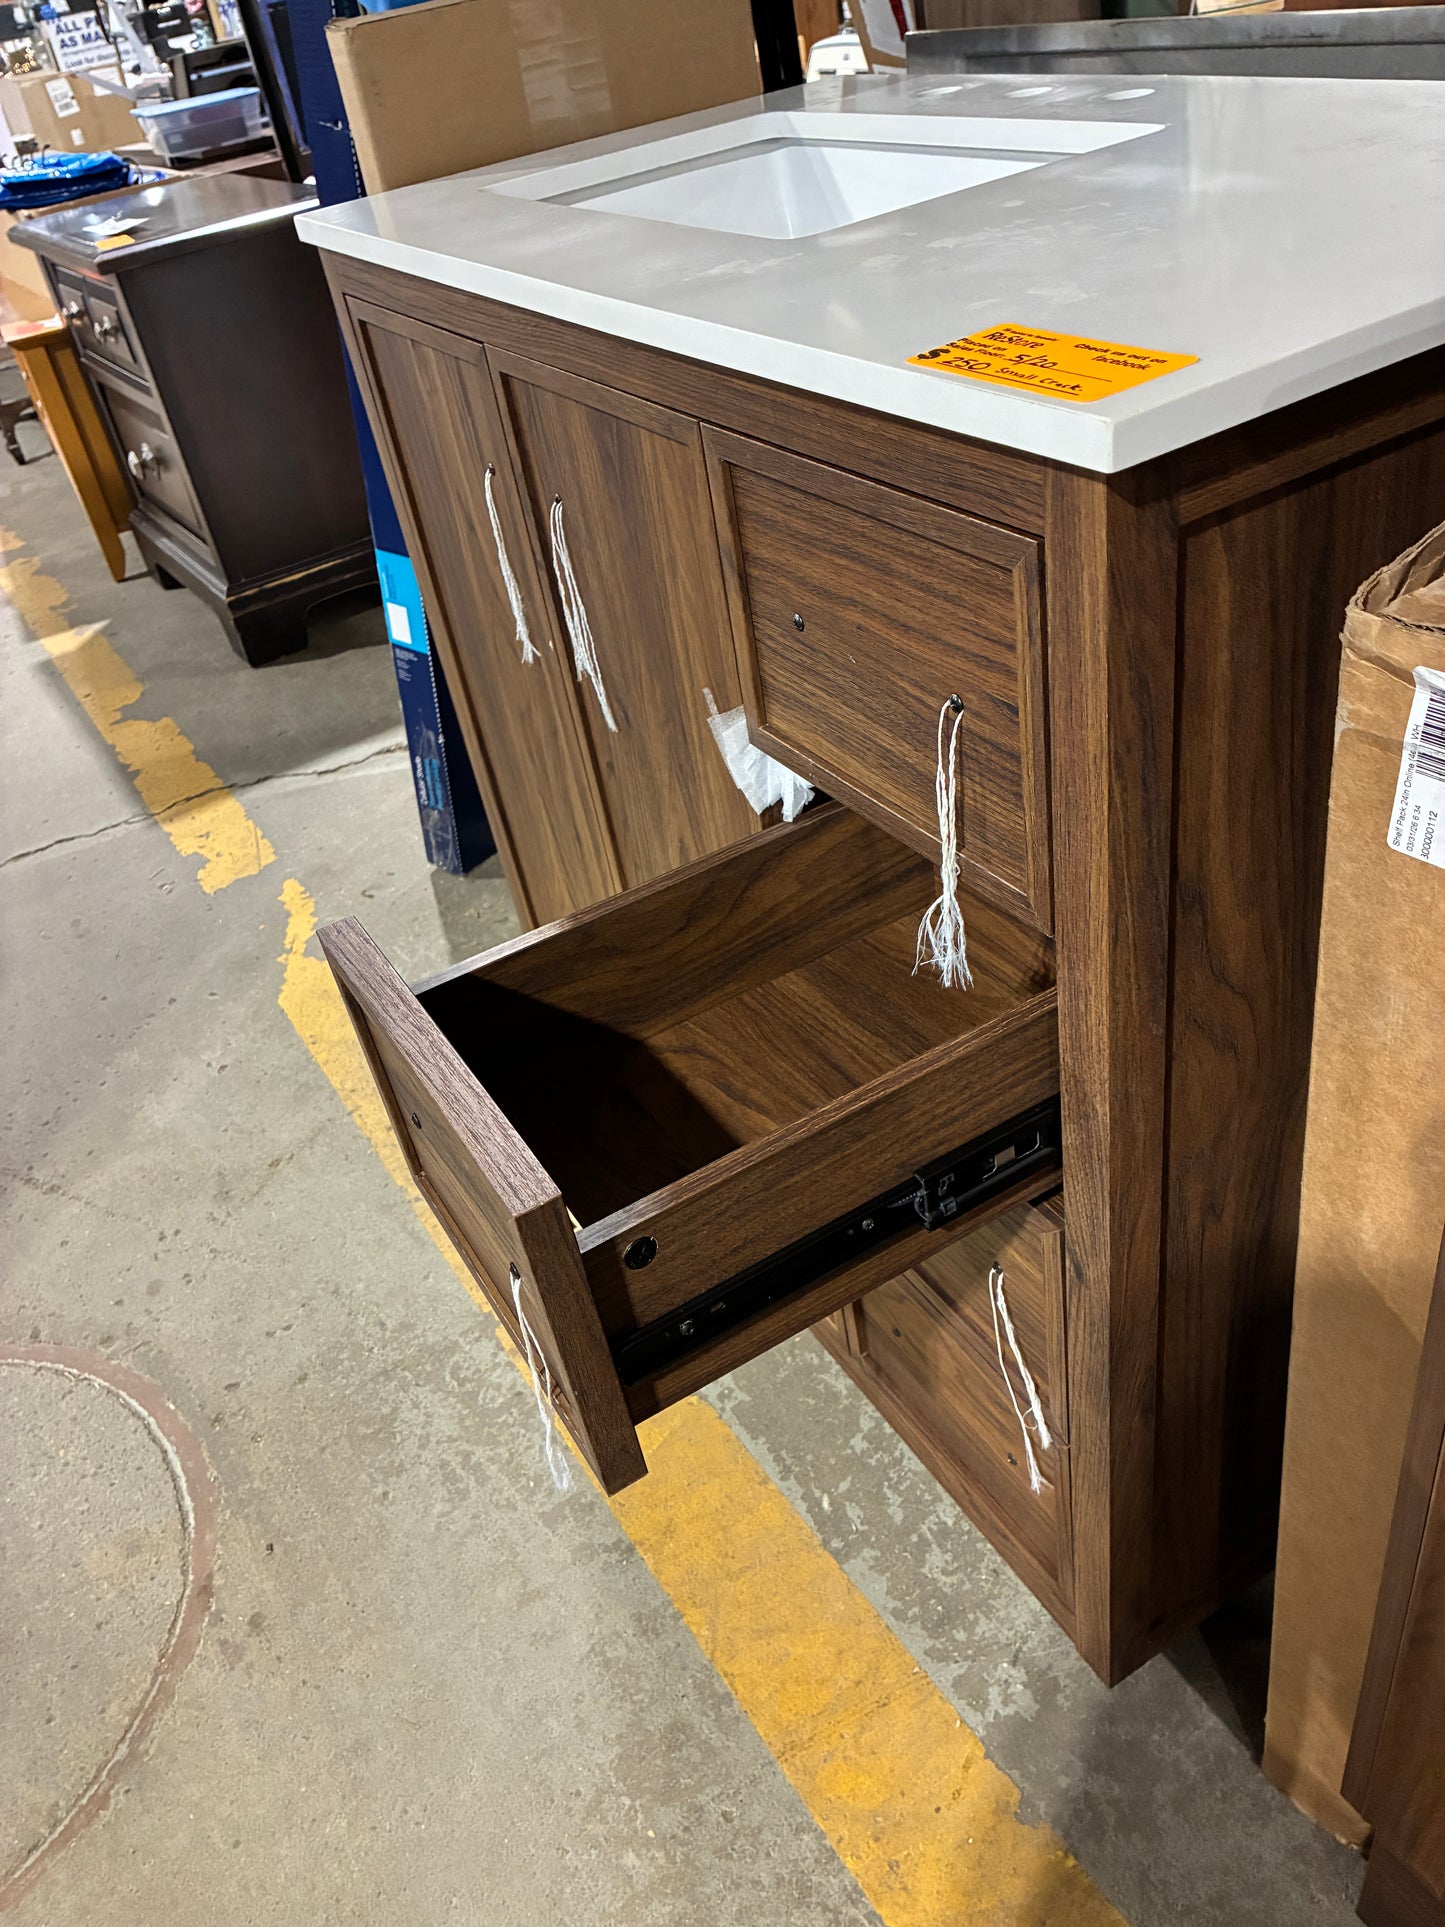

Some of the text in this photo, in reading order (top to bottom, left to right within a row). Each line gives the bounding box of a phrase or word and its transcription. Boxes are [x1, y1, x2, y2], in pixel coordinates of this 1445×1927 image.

[55, 20, 81, 35] ALL
[60, 35, 78, 49] AS
[982, 332, 1044, 348] ReStore
[1074, 343, 1111, 353] Check
[941, 356, 992, 370] 250
[995, 367, 1038, 380] Small
[1010, 354, 1059, 368] 5/20
[1091, 355, 1152, 370] facebook
[1410, 724, 1421, 740] WH
[1403, 763, 1415, 788] Online
[1396, 808, 1406, 826] Pack
[1393, 827, 1403, 847] Shelf
[1406, 822, 1419, 852] 03/31/26
